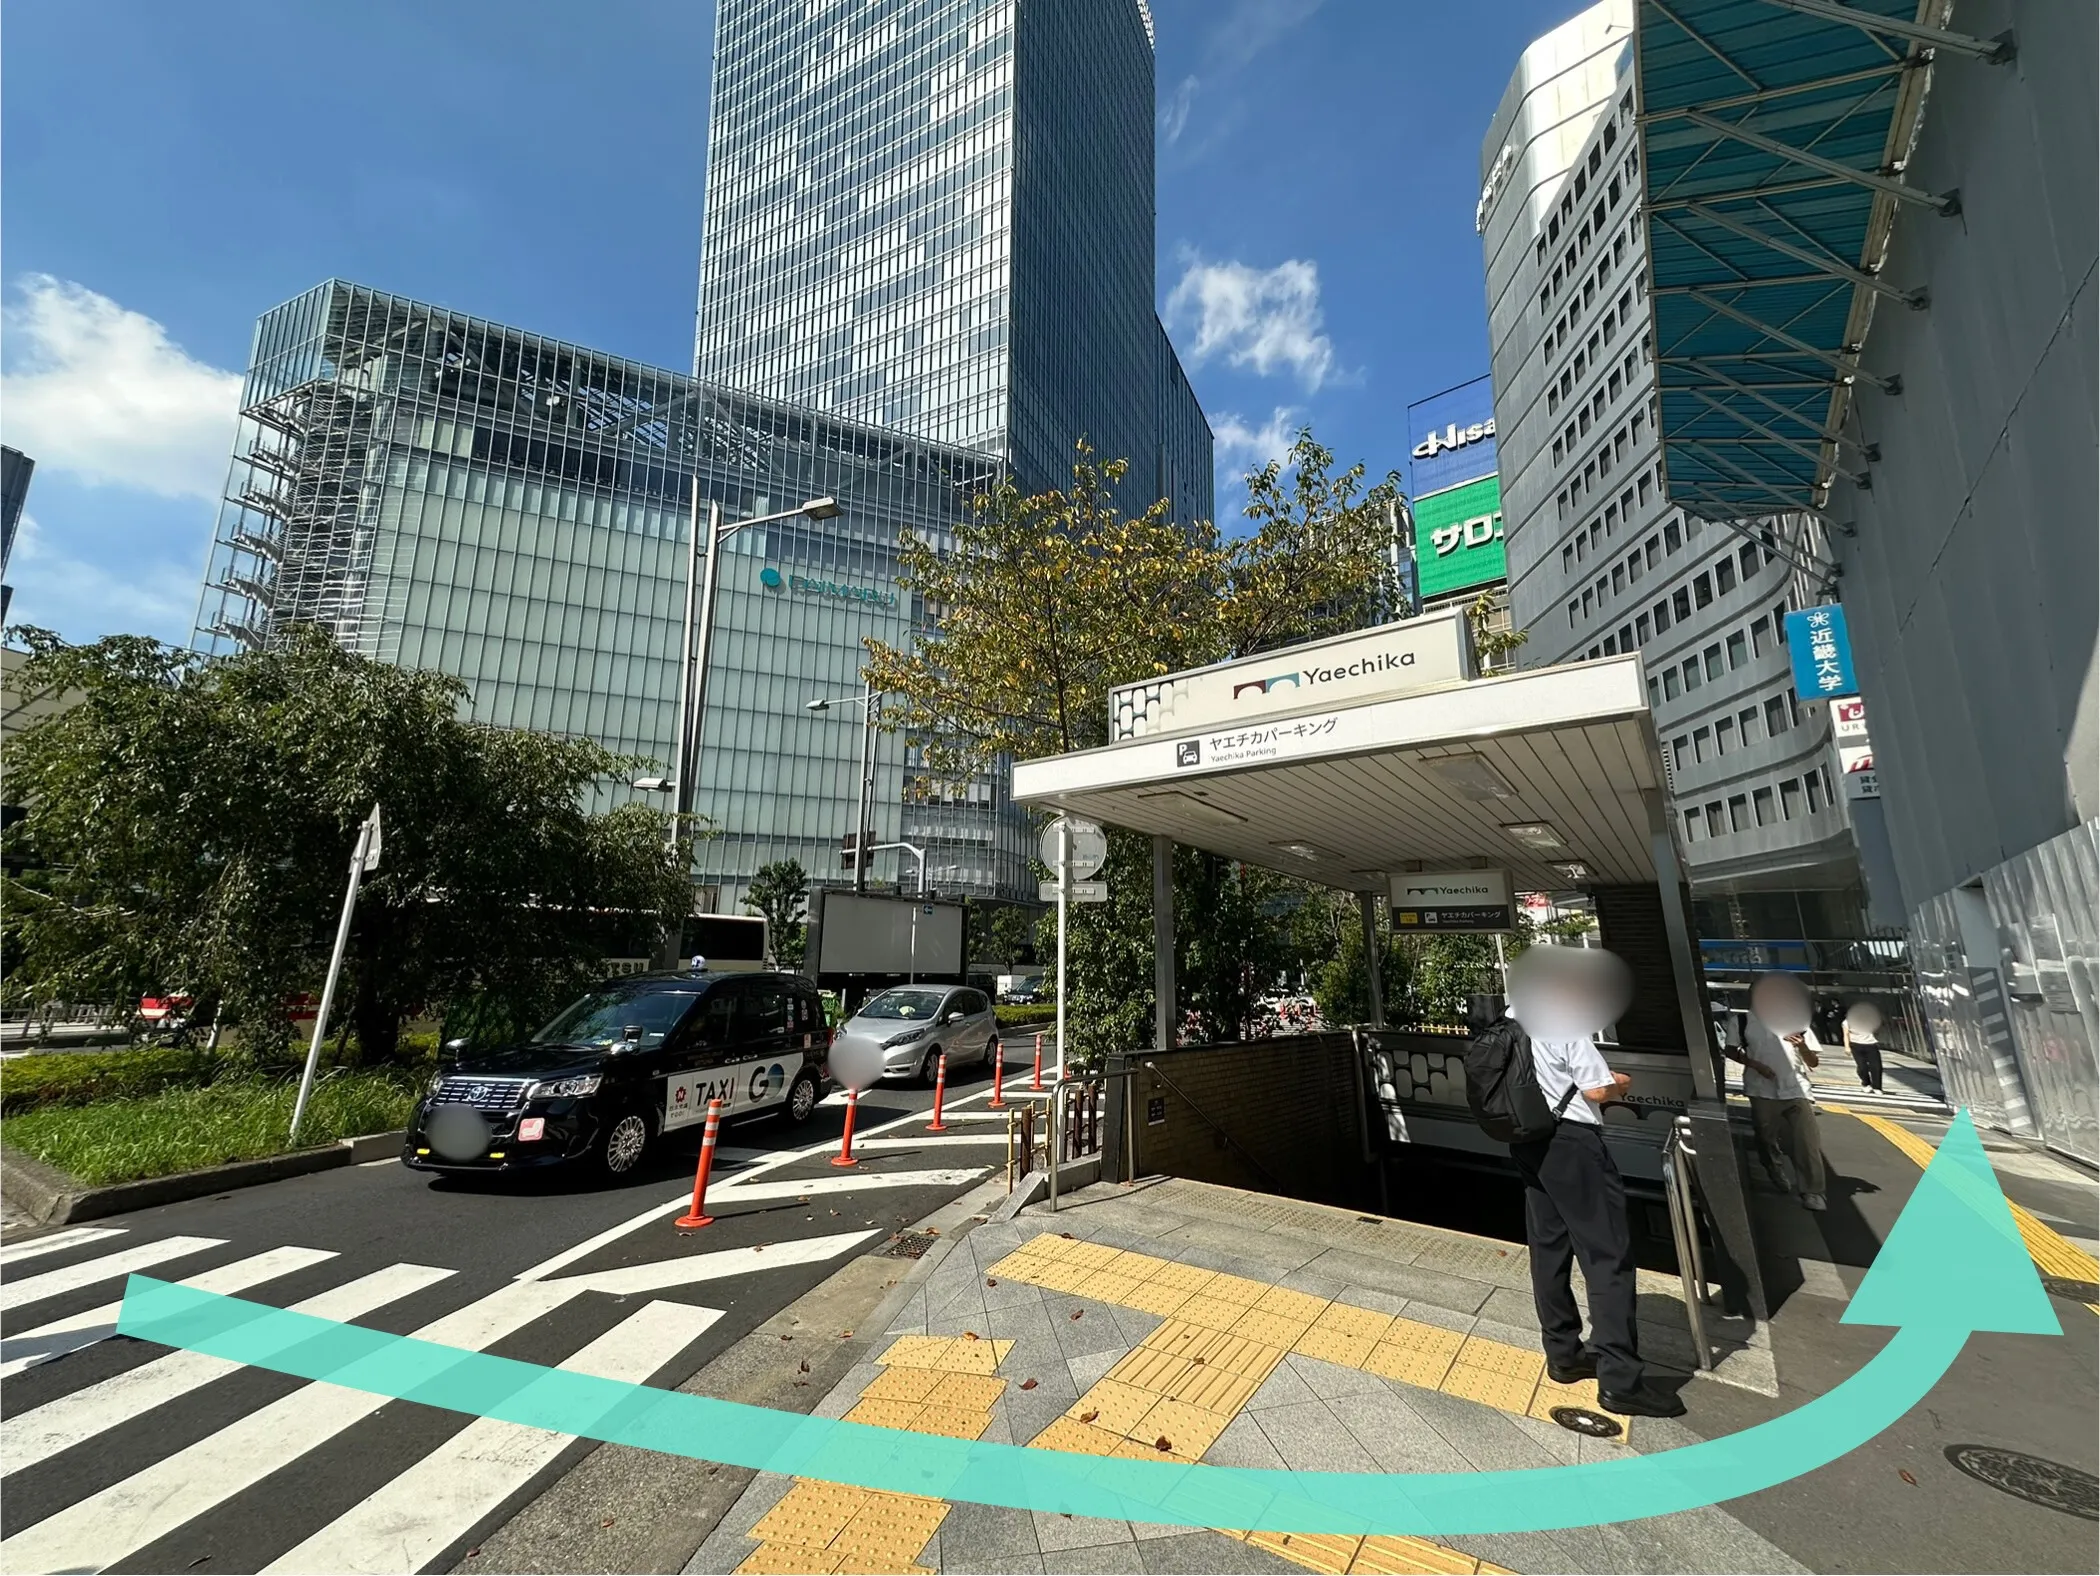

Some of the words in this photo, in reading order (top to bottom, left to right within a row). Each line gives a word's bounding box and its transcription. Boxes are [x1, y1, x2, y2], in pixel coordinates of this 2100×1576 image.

[788, 574, 895, 605] DAIMARU
[1303, 652, 1416, 685] Yaechika
[1810, 628, 1843, 692] 近畿大学
[1209, 717, 1339, 751] ヤエチカパーキング
[1211, 752, 1245, 763] Yaechika
[1246, 747, 1277, 757] Parking
[1440, 886, 1489, 895] Yaechika
[695, 1077, 735, 1107] TAXI
[748, 1063, 785, 1103] GO
[1620, 1092, 1685, 1108] Yaechika
